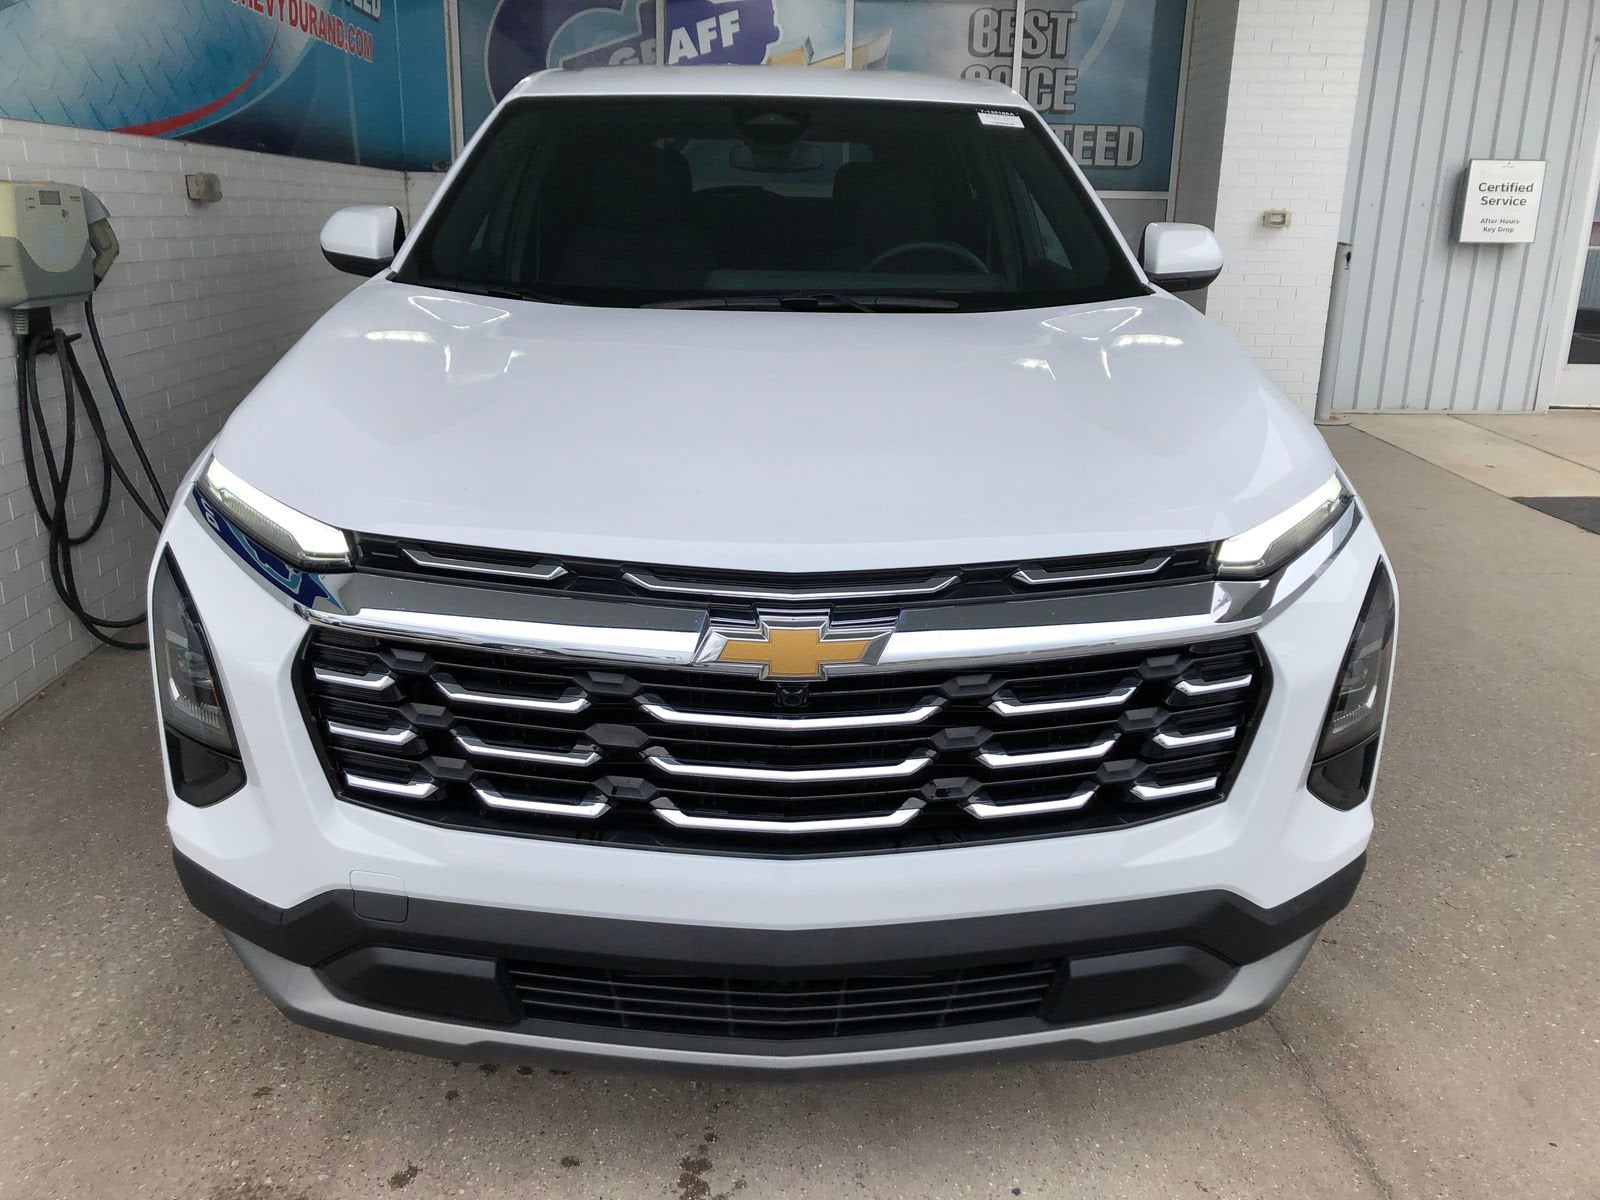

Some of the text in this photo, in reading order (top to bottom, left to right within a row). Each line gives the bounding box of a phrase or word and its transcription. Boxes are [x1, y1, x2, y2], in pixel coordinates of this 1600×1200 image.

[968, 7, 1077, 59] BEST
[1478, 182, 1534, 193] Certified
[1480, 195, 1527, 206] Service
